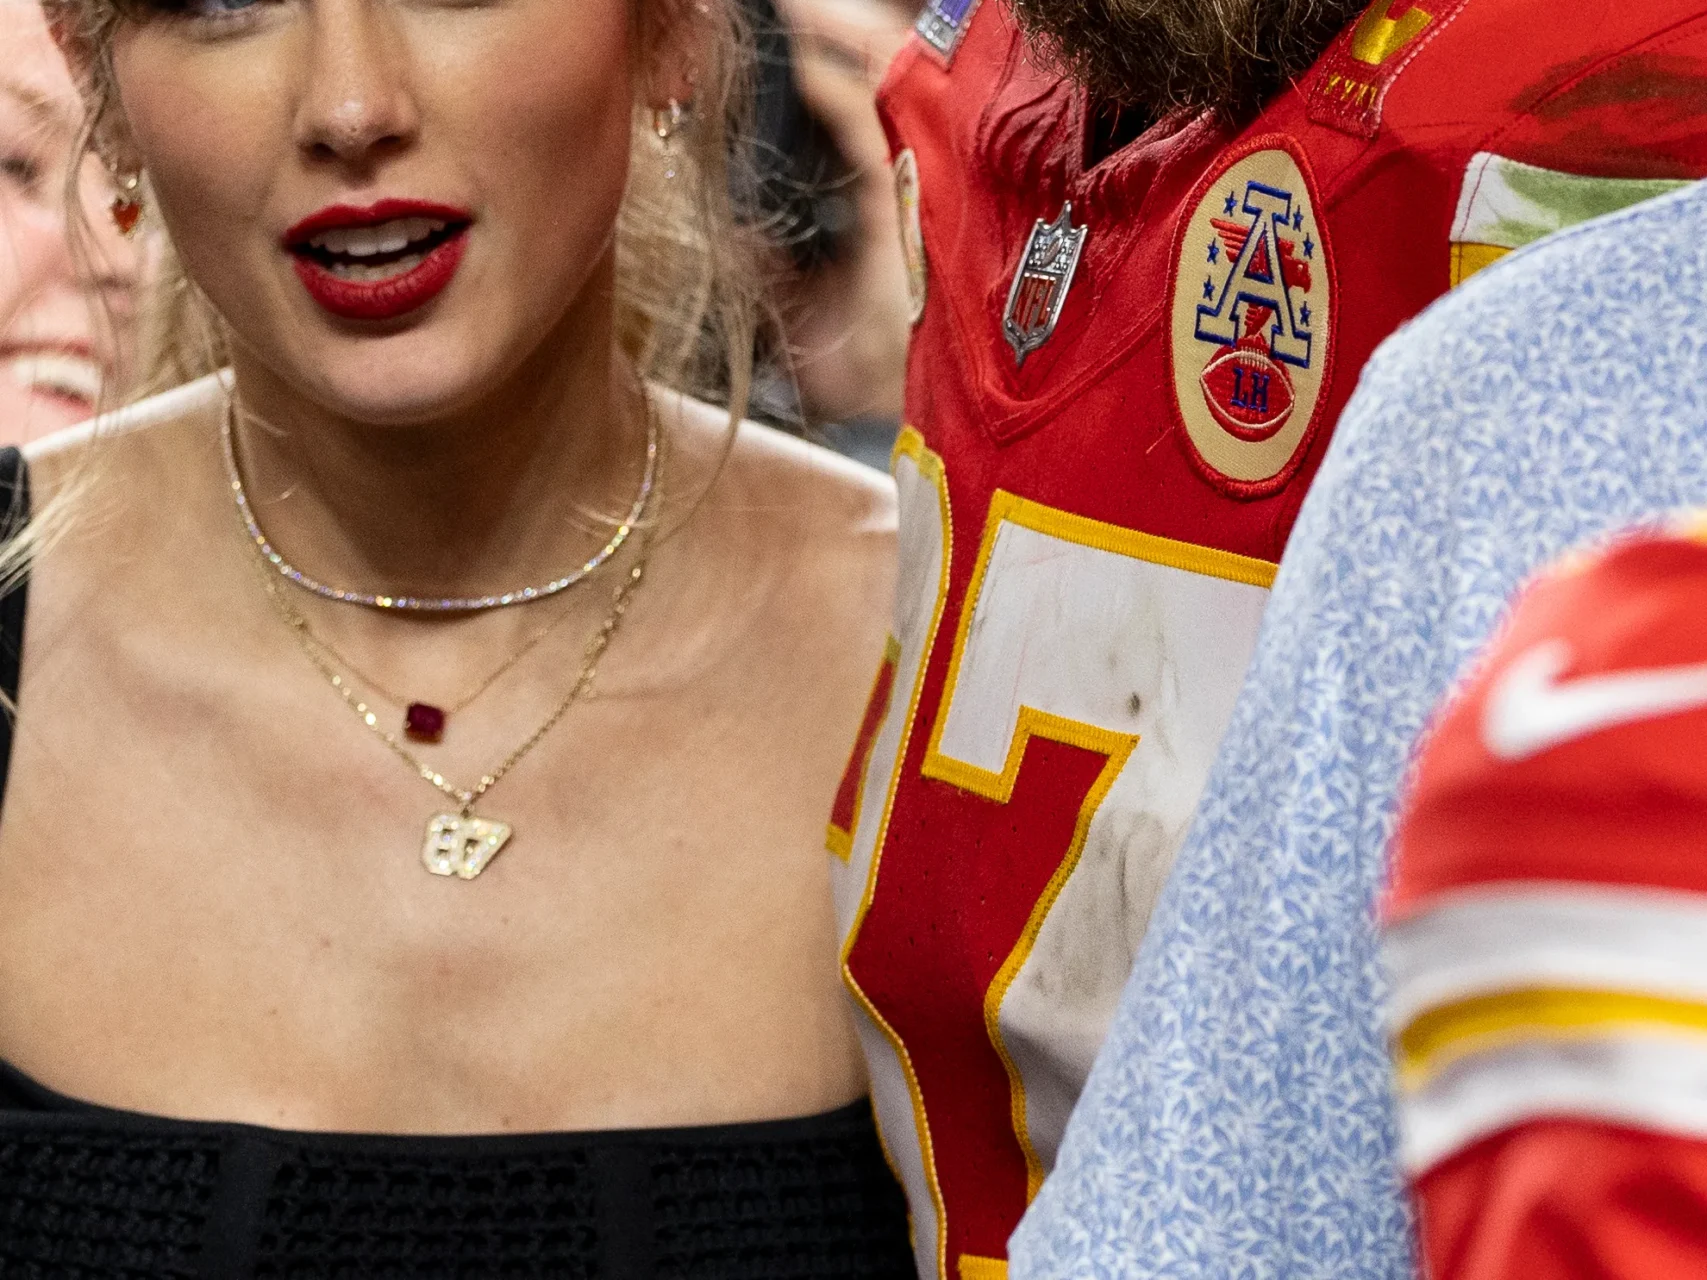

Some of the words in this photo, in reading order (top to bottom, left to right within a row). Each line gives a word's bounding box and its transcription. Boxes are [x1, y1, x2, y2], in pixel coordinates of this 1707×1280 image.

[1194, 180, 1313, 369] A
[1231, 367, 1271, 413] LH
[422, 812, 515, 880] 87
